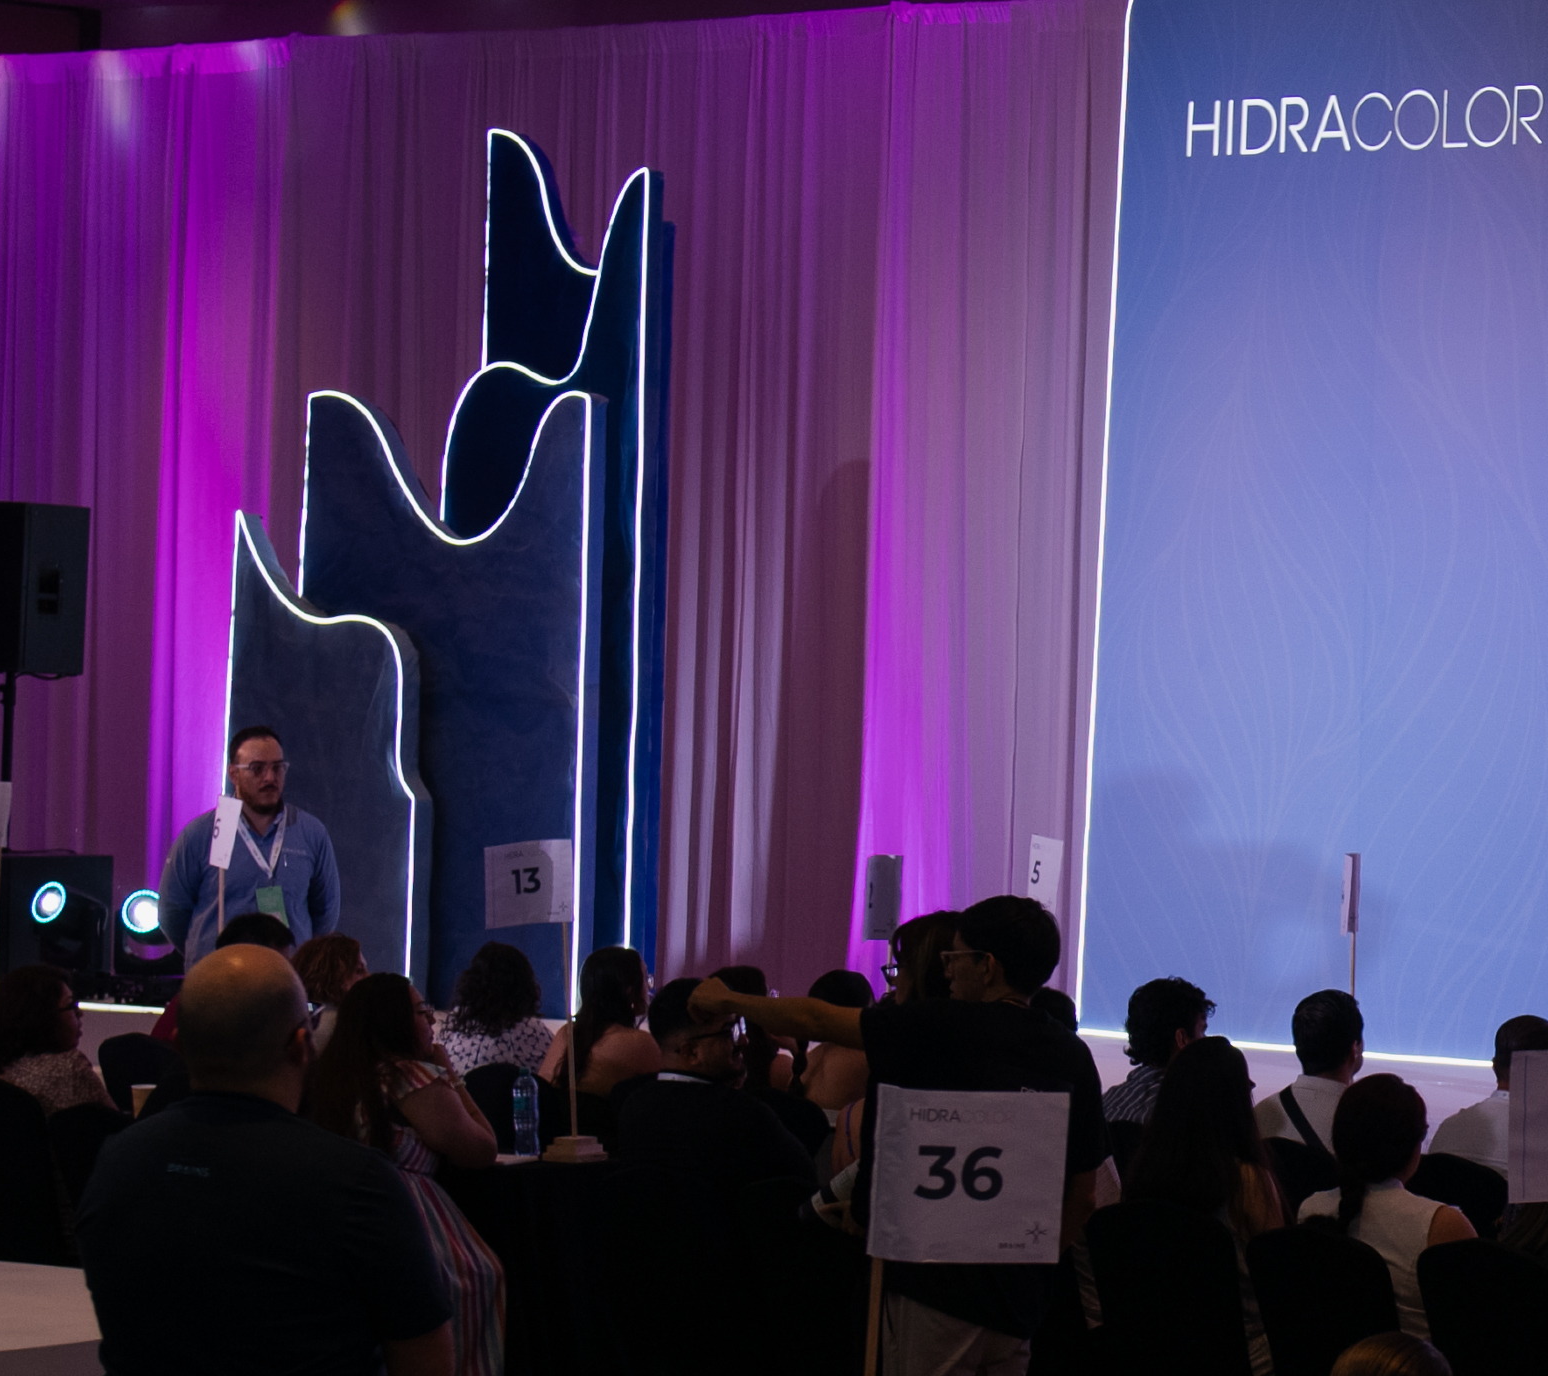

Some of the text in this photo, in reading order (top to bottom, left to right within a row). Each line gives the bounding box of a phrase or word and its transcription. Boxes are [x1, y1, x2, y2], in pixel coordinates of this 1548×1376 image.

[1186, 84, 1544, 158] HIDRACOLOR
[511, 867, 541, 894] 13
[1031, 861, 1041, 884] 5
[914, 1145, 1003, 1200] 36
